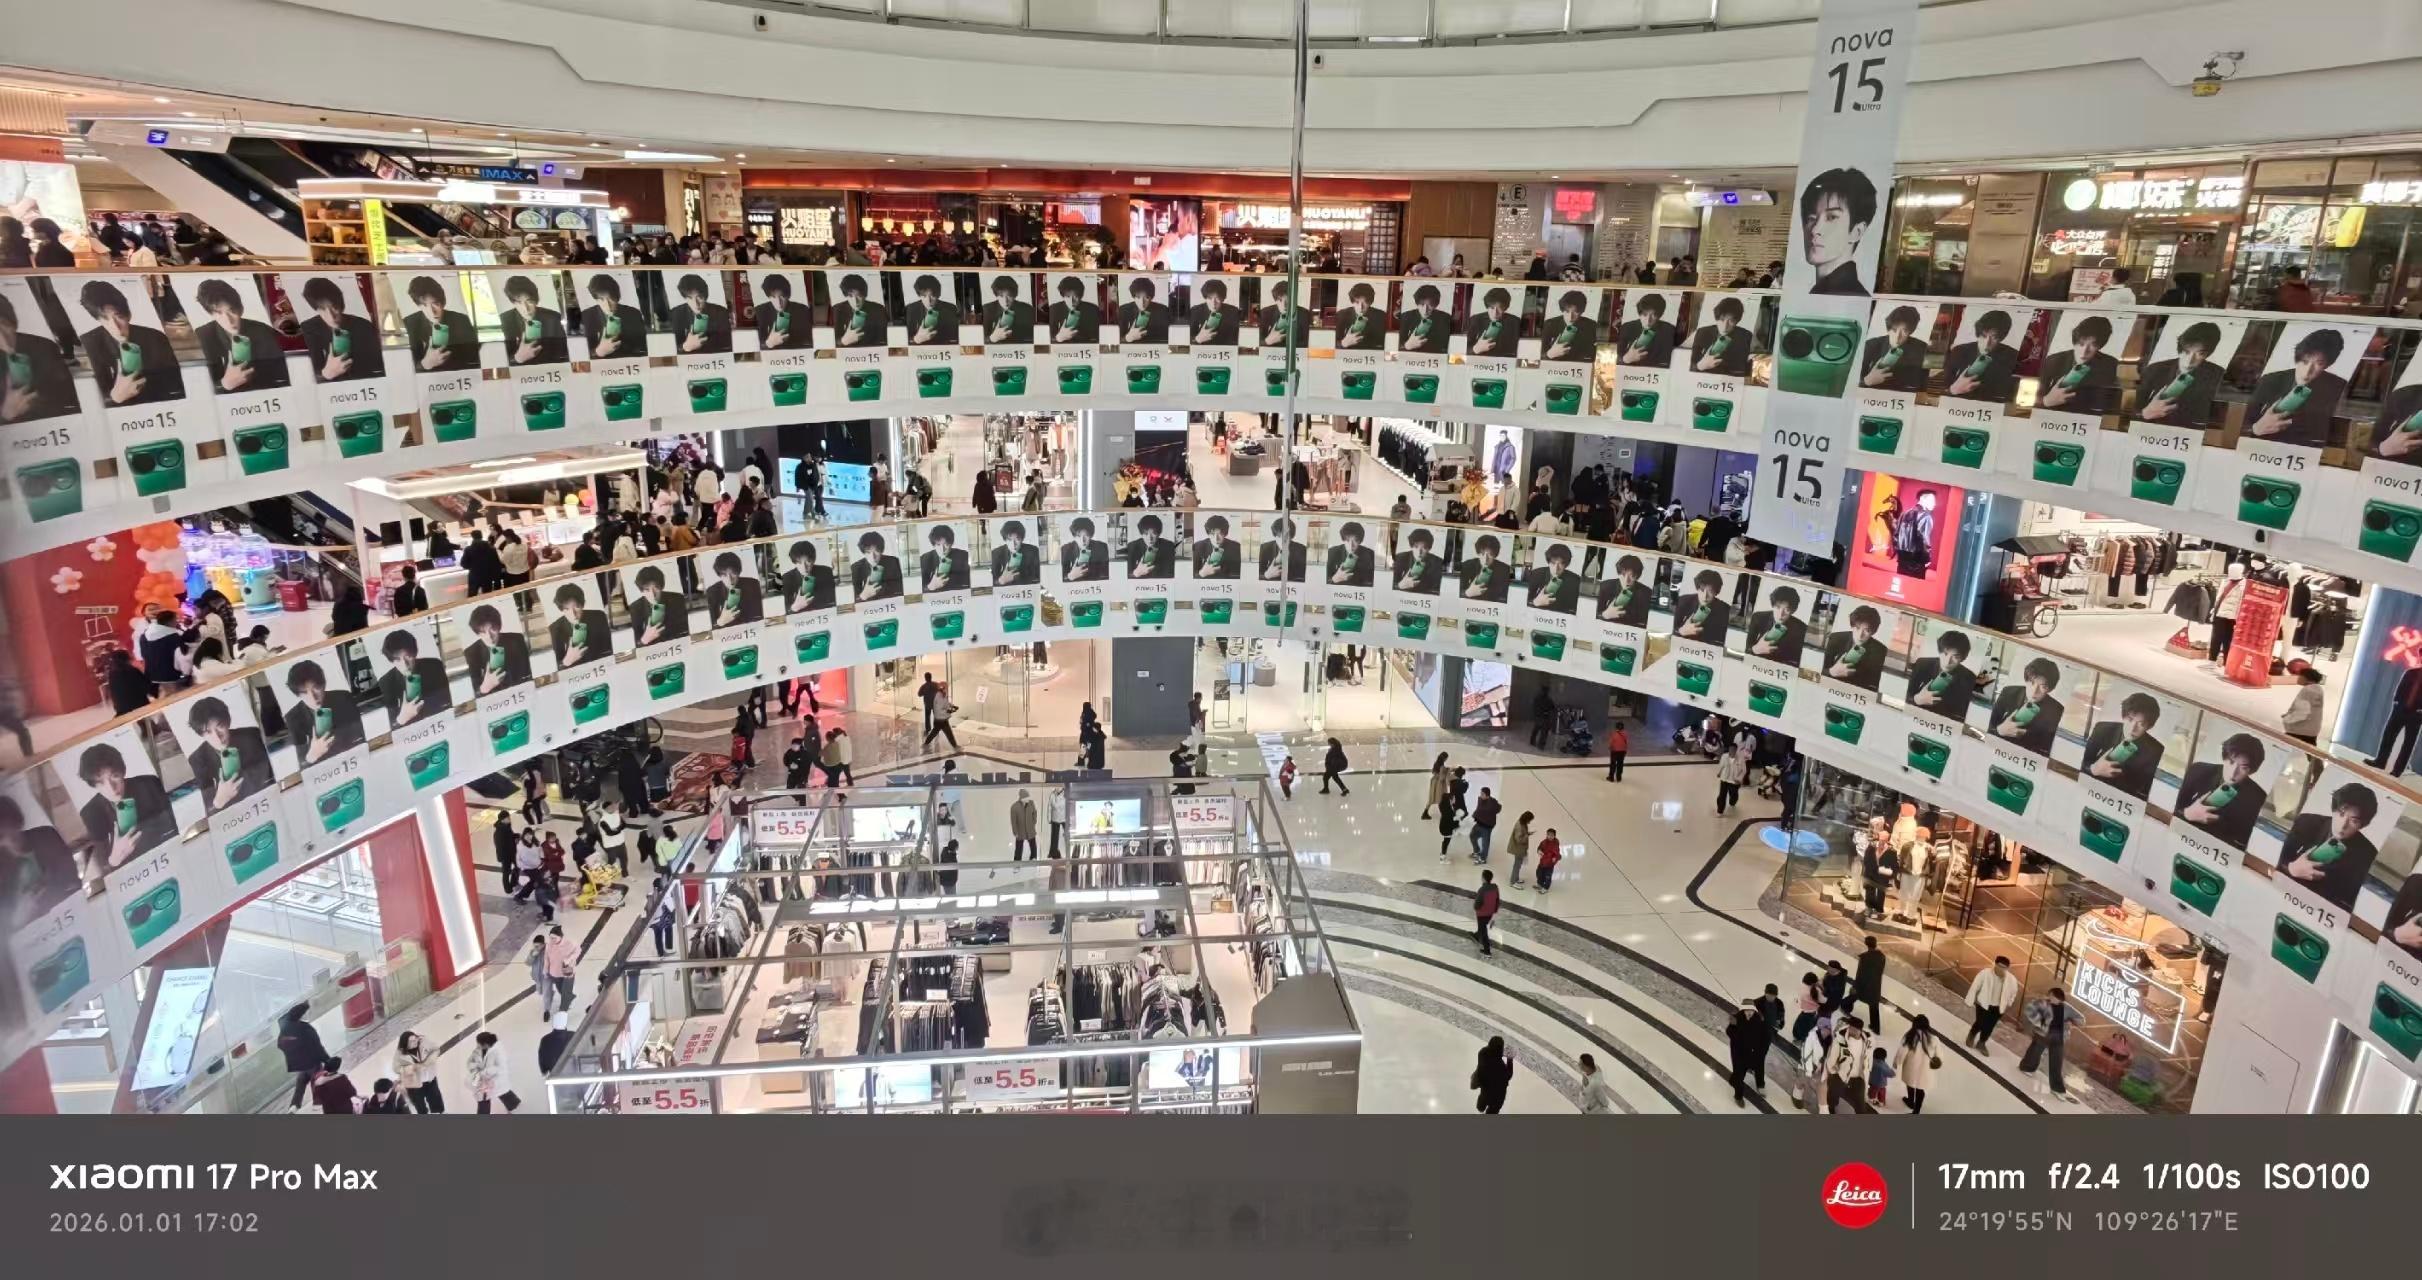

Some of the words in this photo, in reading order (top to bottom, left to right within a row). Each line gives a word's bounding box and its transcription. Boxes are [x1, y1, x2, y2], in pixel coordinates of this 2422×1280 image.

[1831, 28, 1894, 54] nova
[1828, 57, 1886, 113] 15
[482, 169, 522, 180] IMAX
[793, 356, 805, 365] 15
[867, 353, 880, 363] 15
[917, 353, 937, 361] nova
[939, 351, 951, 361] 15
[1014, 350, 1026, 360] 15
[1079, 350, 1091, 359] 15
[1148, 350, 1160, 359] 15
[1197, 352, 1217, 360] nova
[1218, 351, 1230, 360] 15
[1343, 356, 1363, 364] nova
[1364, 355, 1375, 365] 15
[687, 362, 711, 371] nova
[712, 360, 725, 370] 15
[1427, 358, 1439, 368] 15
[1474, 364, 1494, 372] nova
[1495, 362, 1508, 372] 15
[600, 368, 625, 376] nova
[626, 365, 640, 375] 15
[1547, 368, 1569, 376] nova
[1570, 368, 1583, 377] 15
[520, 375, 545, 384] nova
[546, 372, 561, 383] 15
[1623, 374, 1646, 382] nova
[1646, 374, 1659, 384] 15
[428, 382, 455, 392] nova
[456, 378, 472, 390] 15
[1697, 381, 1719, 390] nova
[1721, 382, 1734, 392] 15
[331, 393, 358, 403] nova
[359, 387, 377, 401] 15
[230, 404, 261, 416] nova
[263, 399, 281, 413] 15
[1863, 399, 1889, 408] nova
[1890, 399, 1904, 410] 15
[1948, 407, 1975, 418] nova
[1977, 408, 1992, 422] 15
[121, 418, 154, 431] nova
[155, 412, 176, 428] 15
[2040, 421, 2069, 432] nova
[2071, 422, 2087, 436] 15
[49, 428, 70, 446] 15
[1774, 428, 1830, 452] nova
[2140, 434, 2170, 447] nova
[2172, 436, 2190, 451] 15
[2249, 451, 2283, 467] nova
[2285, 454, 2305, 471] 15
[1772, 454, 1824, 500] 15
[2374, 474, 2410, 491] nova
[2413, 478, 2422, 495] 1
[1021, 589, 1033, 599] 15
[1090, 585, 1102, 594] 15
[1155, 583, 1167, 593] 15
[1221, 584, 1233, 594] 15
[1265, 587, 1281, 595] nov
[1285, 586, 1297, 595] 15
[951, 595, 963, 605] 15
[1333, 592, 1353, 600] nova
[1353, 591, 1365, 600] 15
[884, 603, 896, 613] 15
[1419, 599, 1431, 609] 15
[1466, 607, 1486, 615] nova
[1487, 607, 1499, 617] 15
[816, 614, 829, 625] 15
[1555, 617, 1567, 628] 15
[744, 628, 756, 640] 15
[1624, 631, 1637, 641] 15
[645, 649, 669, 662] nova
[669, 645, 682, 657] 15
[1701, 649, 1714, 661] 15
[568, 672, 591, 685] nova
[592, 664, 606, 678] 15
[1775, 668, 1789, 681] 15
[486, 699, 510, 712] nova
[511, 692, 526, 705] 15
[1828, 687, 1852, 700] nova
[1853, 693, 1867, 706] 15
[1913, 715, 1937, 731] nova
[1938, 723, 1952, 736] 15
[403, 733, 429, 745] nova
[430, 720, 445, 735] 15
[1994, 748, 2021, 764] nova
[2021, 756, 2037, 772] 15
[314, 767, 341, 784] nova
[342, 757, 358, 773] 15
[2087, 787, 2115, 808] nova
[2117, 799, 2133, 816] 15
[222, 812, 252, 832] nova
[252, 799, 270, 817] 15
[1190, 808, 1216, 821] 5.5
[777, 821, 806, 835] 5.5
[2180, 833, 2210, 855] nova
[2212, 847, 2230, 867] 15
[119, 868, 150, 893] nova
[150, 853, 170, 873] 15
[2284, 891, 2314, 915] nova
[2317, 908, 2335, 929] 15
[2387, 958, 2419, 986] nova
[2080, 964, 2141, 1008] KICKS
[2077, 979, 2155, 1036] LOUNGE
[996, 1068, 1036, 1088] 5.5
[655, 1088, 698, 1110] 5.5
